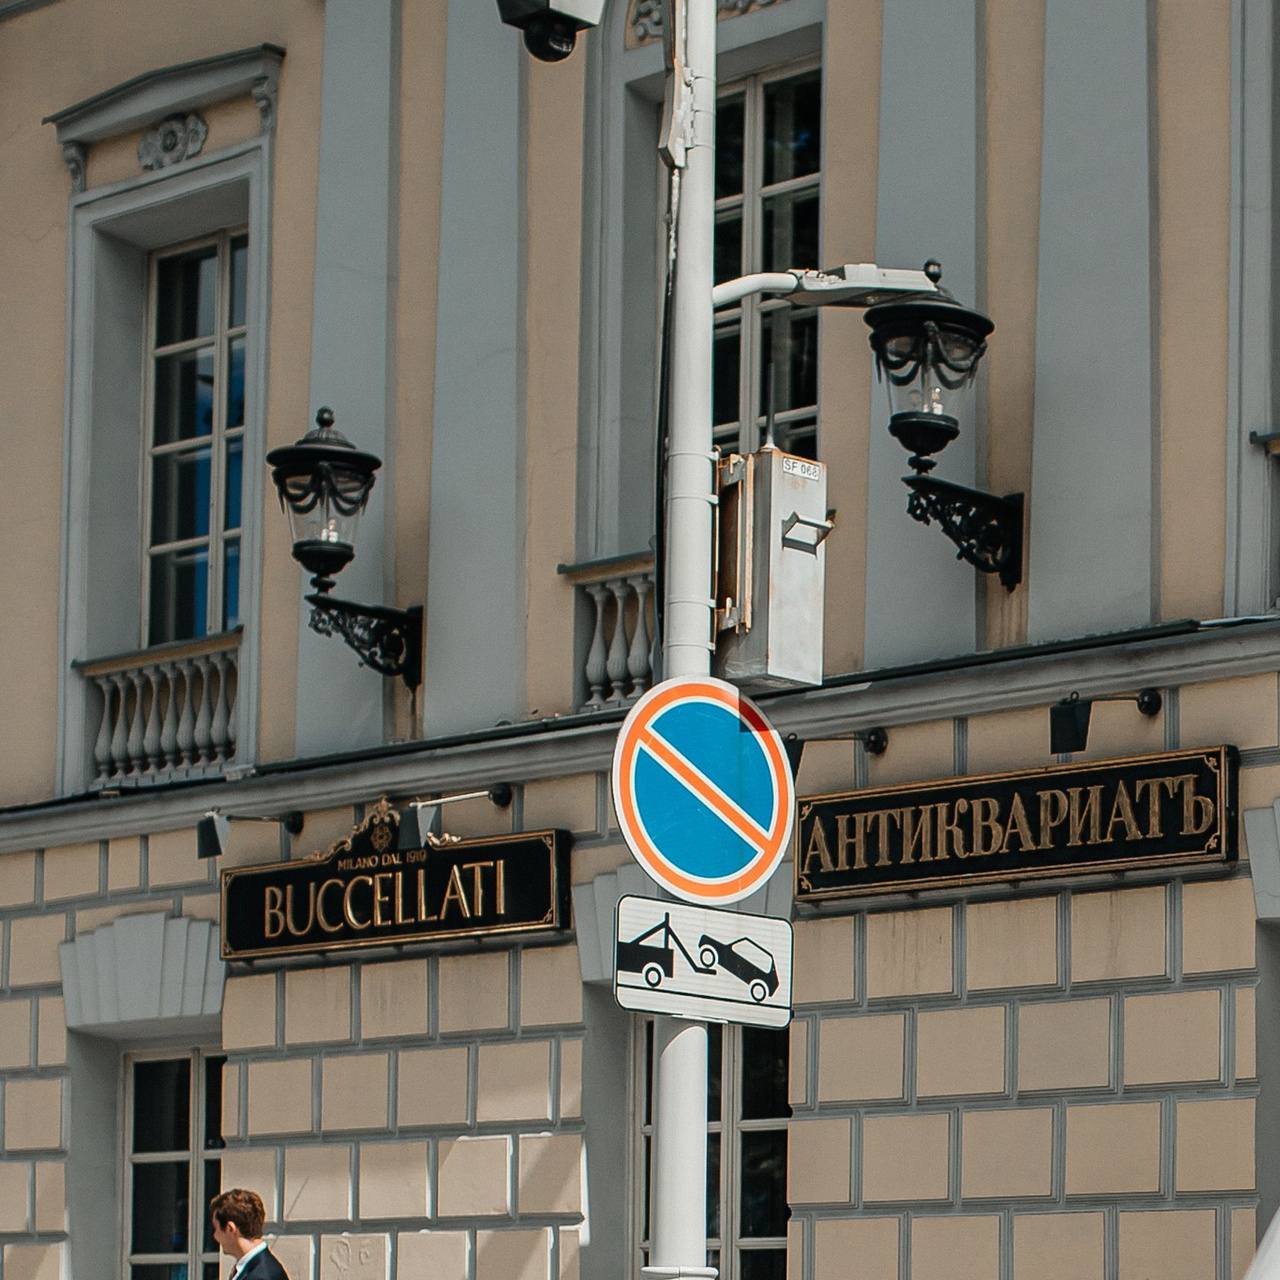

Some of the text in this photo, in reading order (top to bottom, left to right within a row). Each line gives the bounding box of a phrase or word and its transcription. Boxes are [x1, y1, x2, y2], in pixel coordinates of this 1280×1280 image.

[784, 459, 798, 471] SF
[802, 773, 1216, 875] АНТИКВАРИАТЪ
[337, 855, 379, 871] MILANO
[381, 852, 402, 867] DAL
[264, 858, 505, 939] BUCCELLATI
